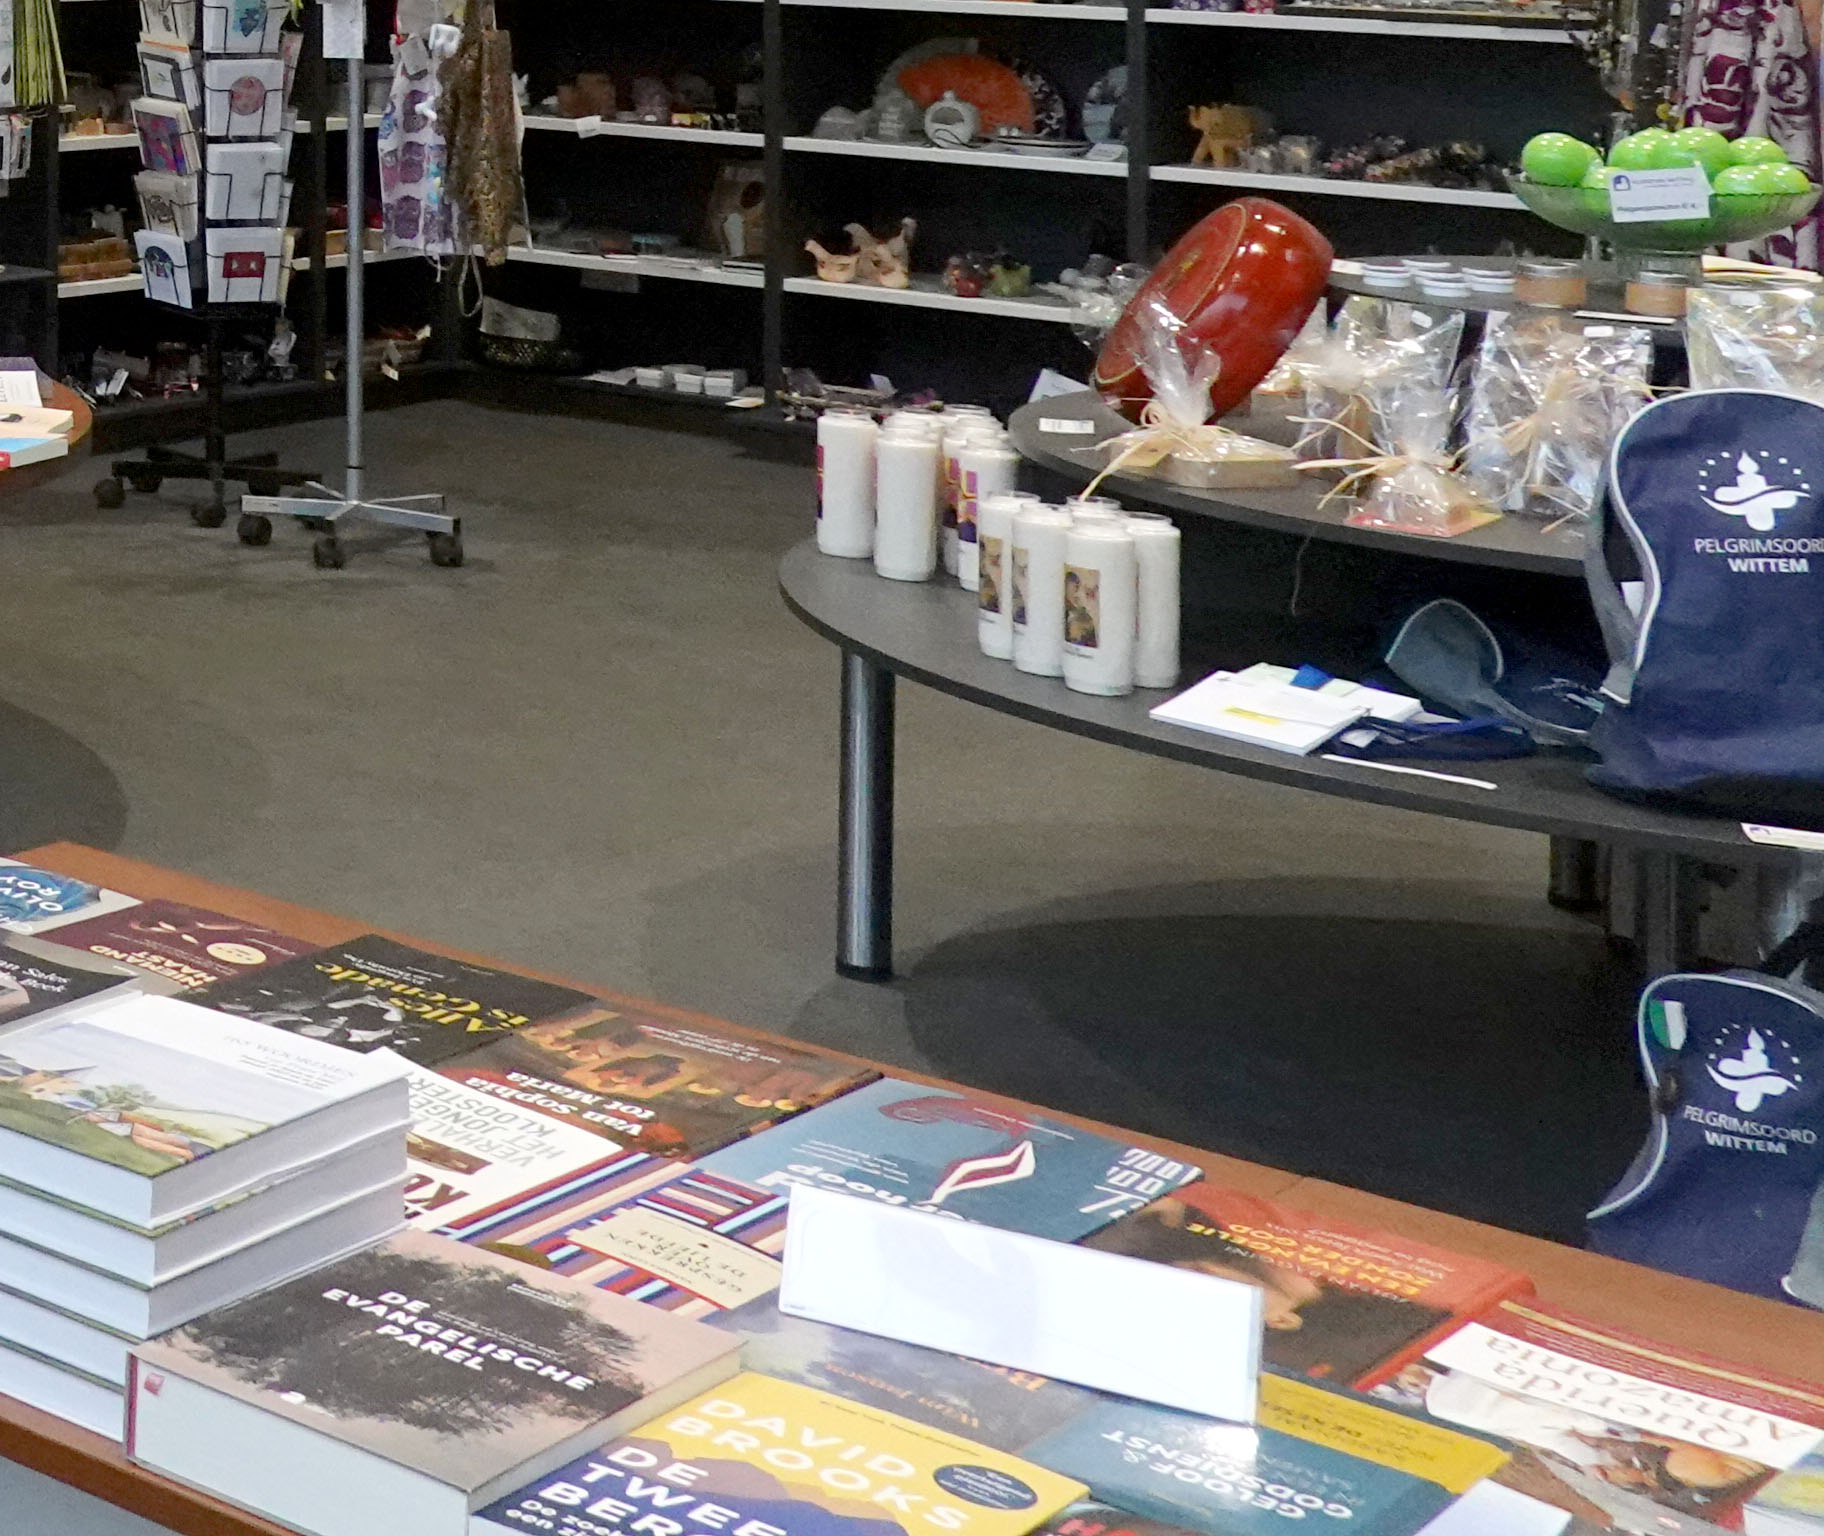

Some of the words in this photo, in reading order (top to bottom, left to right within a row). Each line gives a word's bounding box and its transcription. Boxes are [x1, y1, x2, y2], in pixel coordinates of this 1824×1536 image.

[1727, 557, 1810, 574] WITTEM
[89, 945, 204, 988] NIEMAND
[131, 951, 218, 983] HAAST
[315, 962, 481, 1014] Genade
[388, 996, 511, 1033] Alles
[489, 1007, 531, 1026] is
[464, 1076, 580, 1115] Sophia
[505, 1071, 605, 1110] Maria
[581, 1110, 643, 1137] van
[602, 1103, 656, 1120] tot
[1683, 1105, 1818, 1145] PELGRIMSOORD
[522, 1135, 566, 1160] HET
[1704, 1130, 1788, 1155] WITTEM
[1185, 1222, 1353, 1277] EVANGELIE
[1227, 1222, 1298, 1247] GOD
[1302, 1243, 1435, 1288] ZONDER
[1355, 1270, 1421, 1296] EEN
[377, 1291, 430, 1314] DE
[322, 1287, 595, 1392] EVANGELISCHE
[376, 1324, 484, 1371] PAREL
[1485, 1334, 1810, 1442] Amazonia
[1493, 1361, 1750, 1449] Querida
[698, 1398, 918, 1479] DAVID
[606, 1445, 710, 1486] DE
[666, 1414, 970, 1530] BROOKS
[1101, 1429, 1354, 1520] GODSDIENST
[520, 1499, 557, 1517] De
[580, 1462, 788, 1536] TWEE
[1148, 1461, 1307, 1520] GELOOF
[505, 1508, 554, 1530] een
